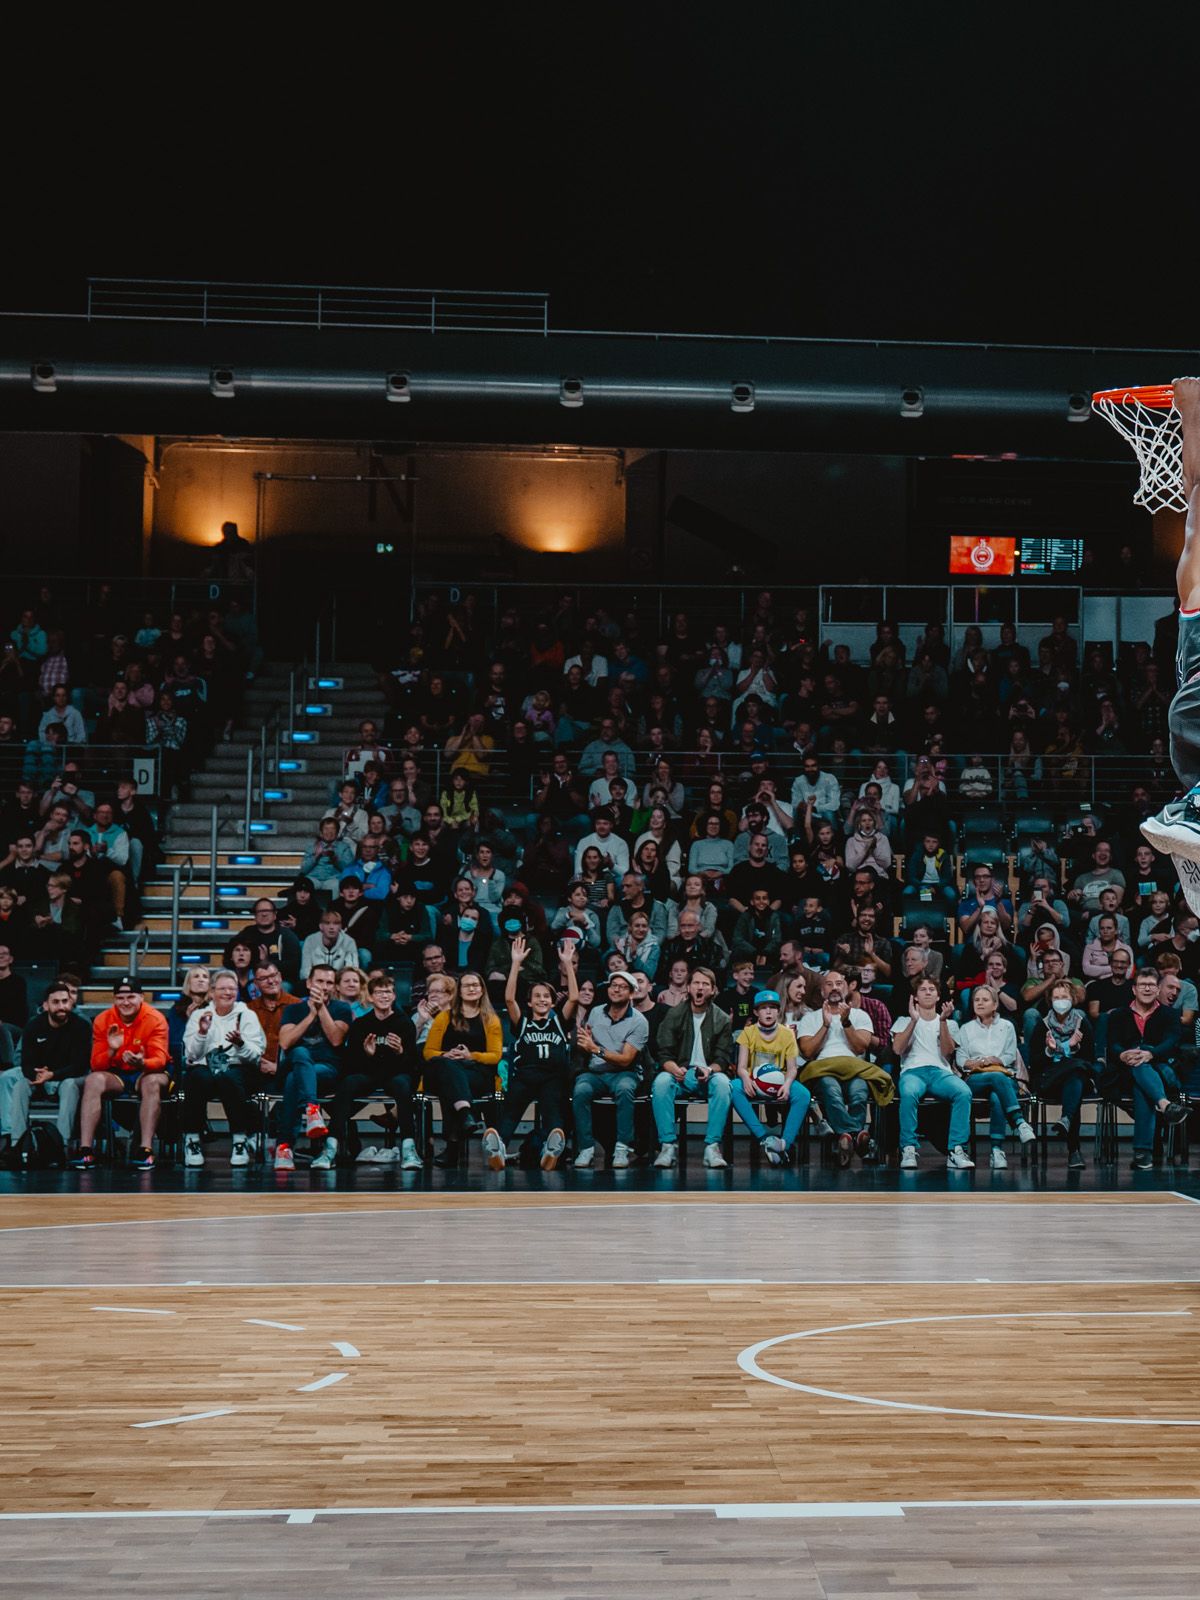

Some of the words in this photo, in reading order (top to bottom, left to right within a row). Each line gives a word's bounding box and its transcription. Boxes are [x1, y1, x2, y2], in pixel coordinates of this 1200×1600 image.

[208, 583, 221, 600] D
[448, 586, 461, 604] D
[138, 768, 150, 786] D
[536, 1044, 550, 1059] 11
